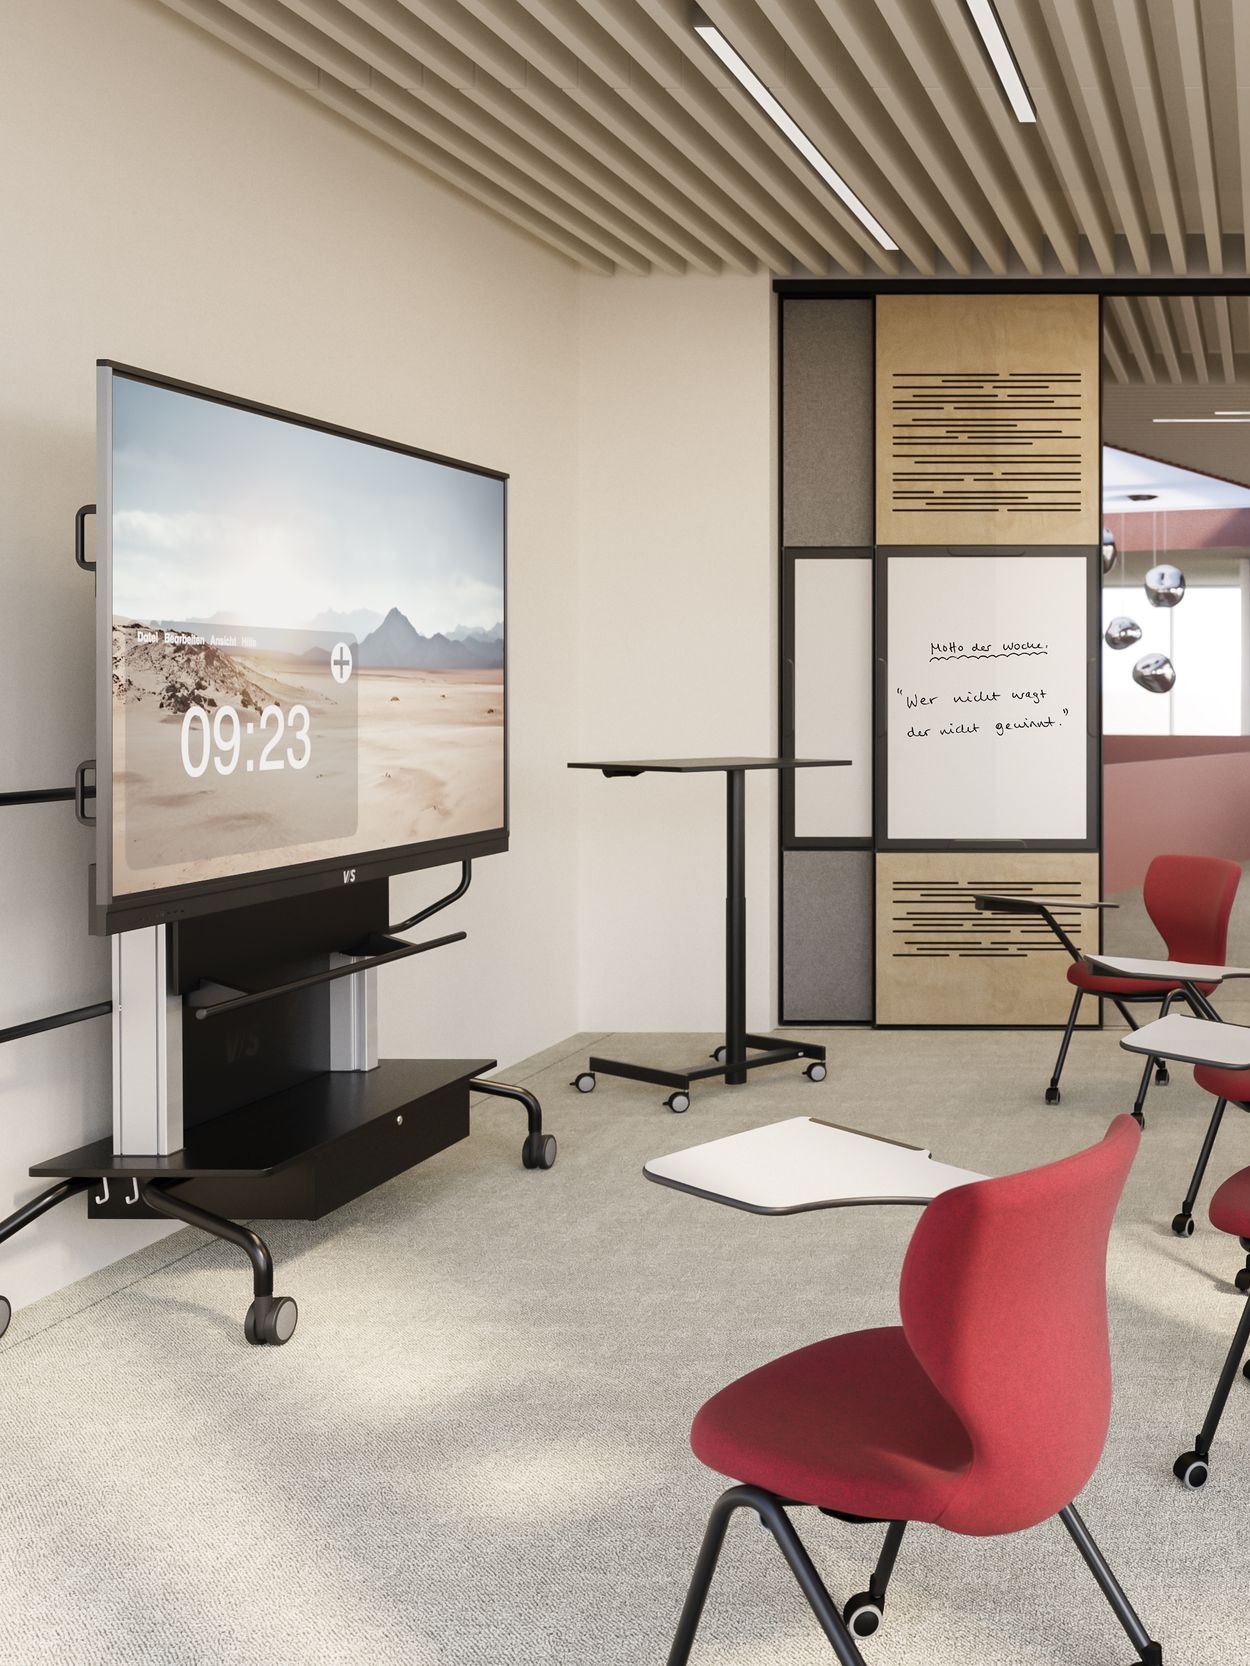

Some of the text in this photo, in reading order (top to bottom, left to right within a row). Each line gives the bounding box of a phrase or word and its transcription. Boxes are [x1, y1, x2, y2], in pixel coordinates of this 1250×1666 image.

[137, 631, 159, 643] Datei
[164, 632, 205, 646] Bearbeiten
[210, 635, 237, 646] Ansicht
[930, 641, 964, 655] Motto
[971, 643, 992, 652] der
[953, 691, 1001, 704] nicht
[907, 727, 931, 738] der
[940, 723, 980, 736] nicht
[181, 704, 311, 778] 09:23
